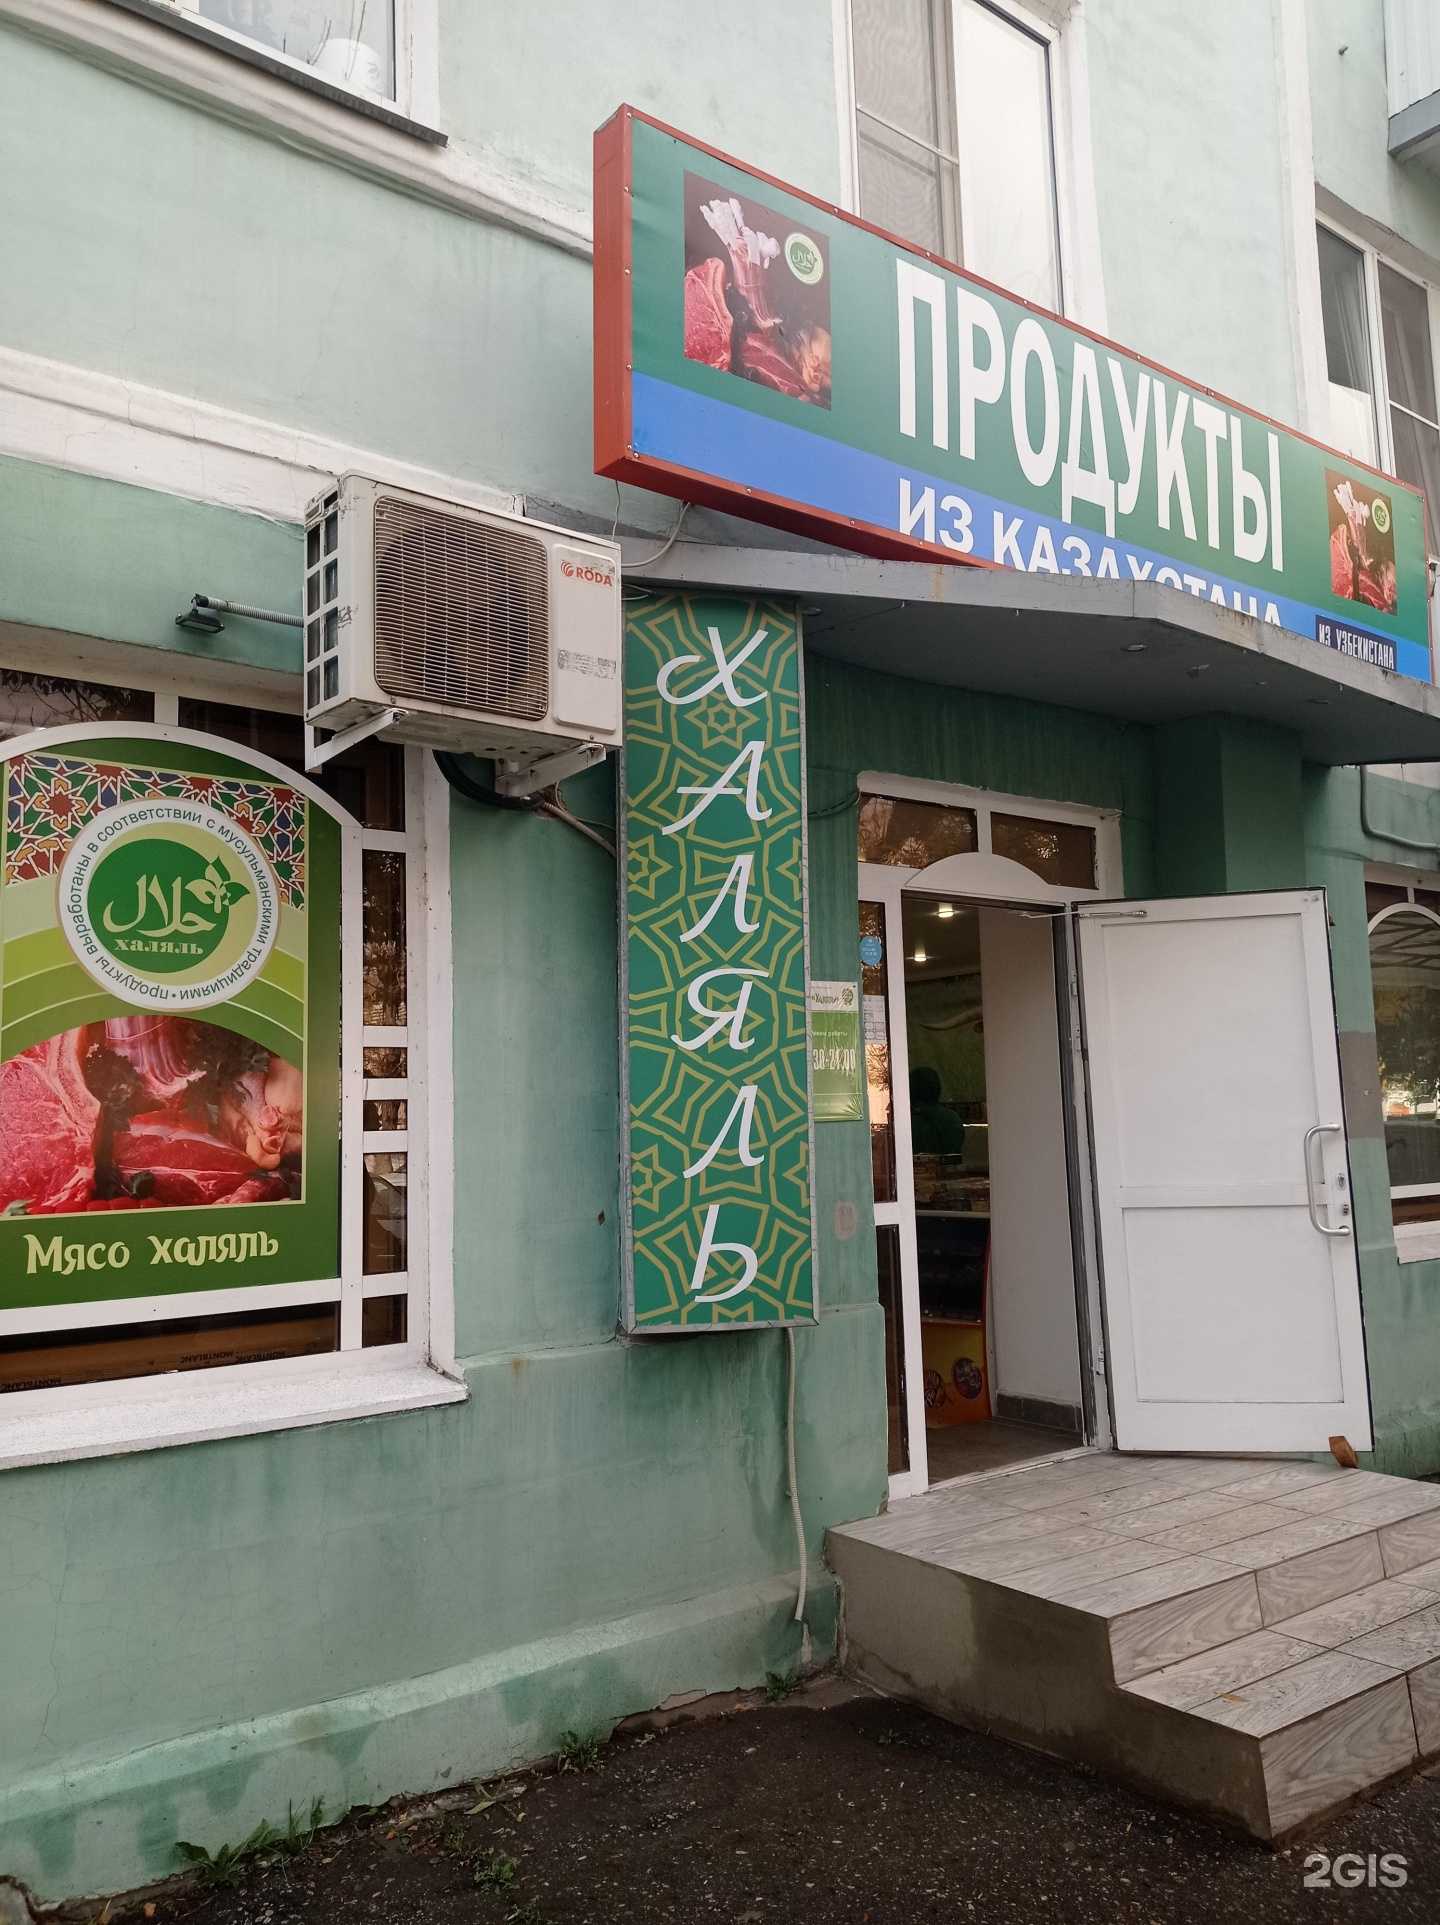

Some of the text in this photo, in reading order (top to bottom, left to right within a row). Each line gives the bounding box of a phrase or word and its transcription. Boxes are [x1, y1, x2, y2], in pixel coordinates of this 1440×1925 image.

[896, 258, 1283, 572] ПРОДУКТЫ
[899, 478, 974, 553] ИЗ
[576, 566, 612, 587] RÖDA
[1318, 623, 1394, 669] ИЗ УЗБЕКИСТАНА
[67, 807, 273, 1000] продукты выработаны в соответствии с мусульманскими традициями
[113, 938, 204, 955] халяль
[656, 625, 772, 1303] ХАЛЯЛЬ
[23, 1231, 279, 1275] Мясо халяль
